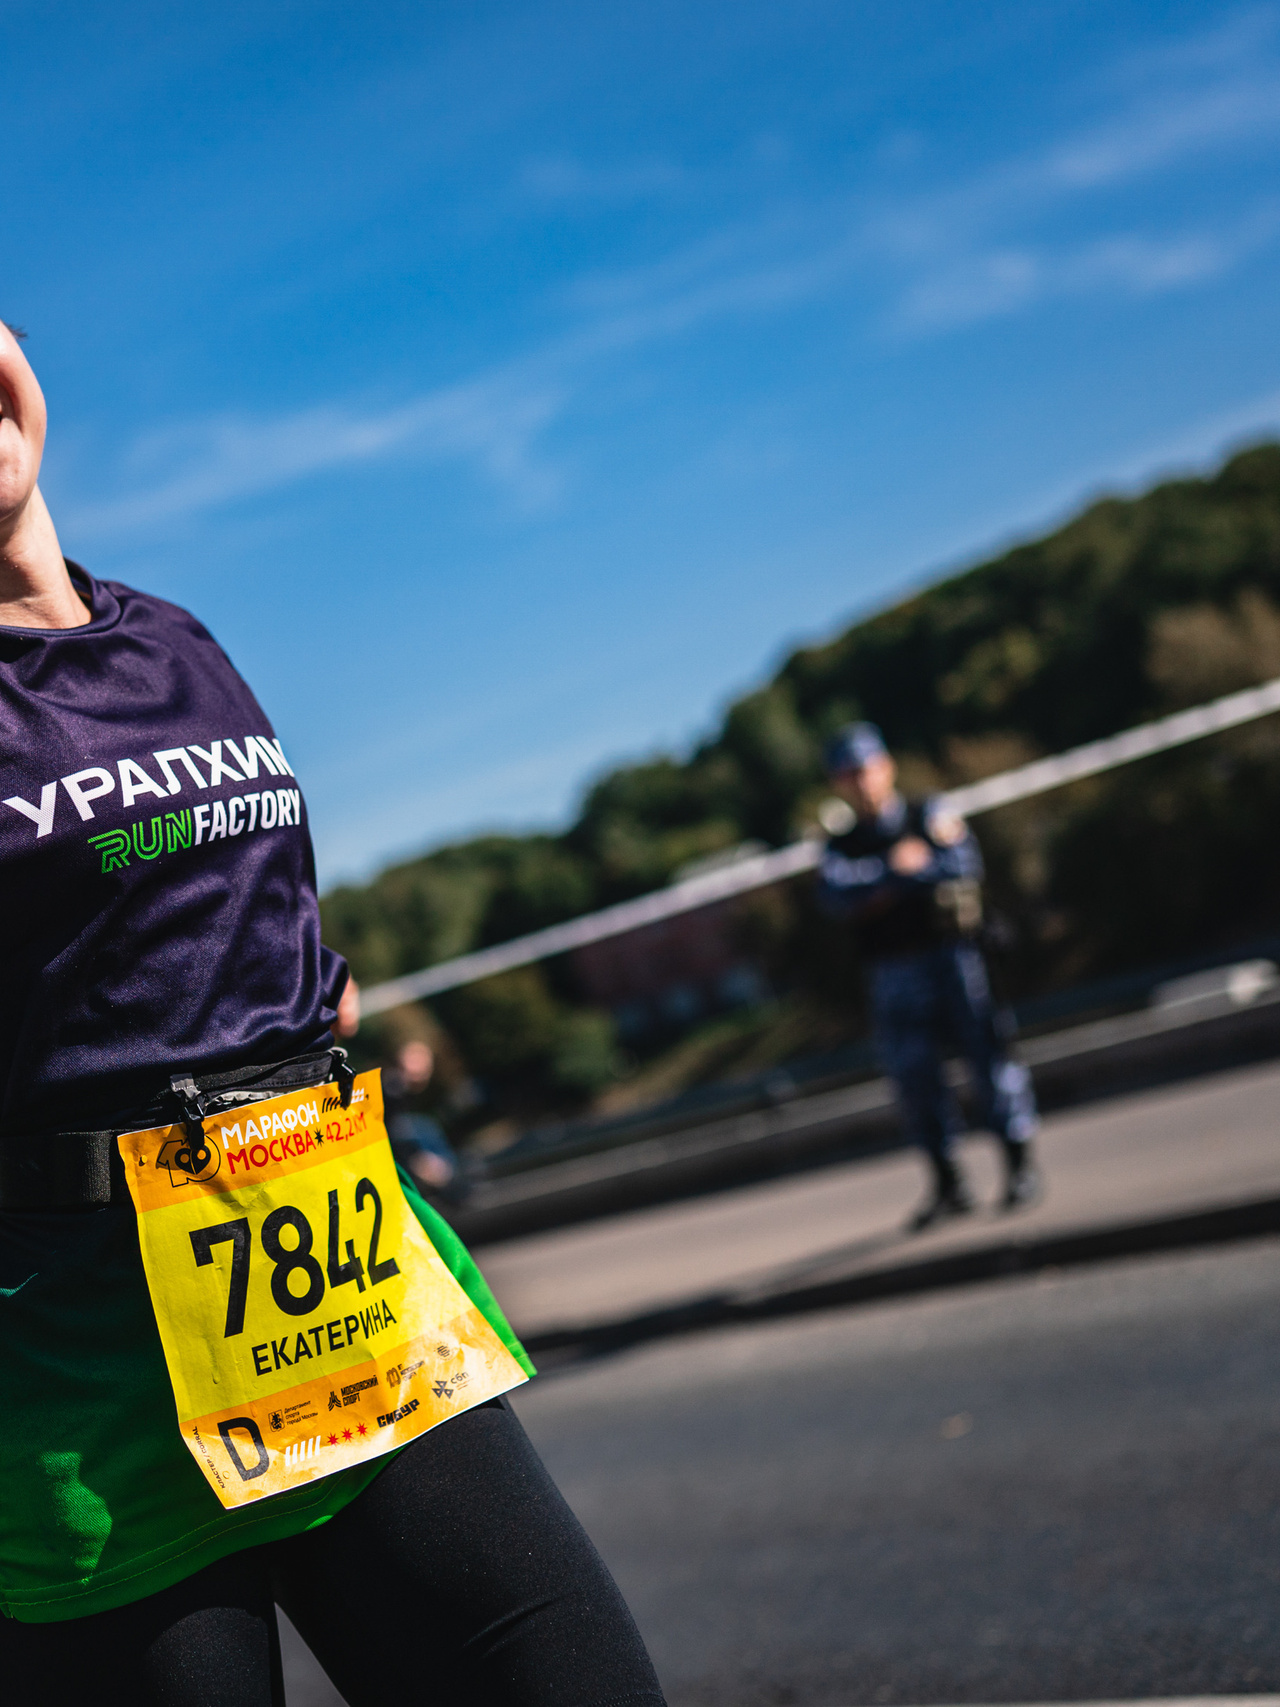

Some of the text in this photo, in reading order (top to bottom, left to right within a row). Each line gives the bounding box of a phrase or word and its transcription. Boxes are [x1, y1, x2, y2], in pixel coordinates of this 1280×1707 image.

[220, 1100, 320, 1149] МАРАФОН
[226, 1129, 317, 1175] МОСКВА
[188, 1177, 401, 1339] 7842
[251, 1298, 397, 1377] ЕКАТЕРИНА
[340, 1374, 379, 1396] МОСКОВСКИЙ
[342, 1392, 361, 1407] СПОРТ
[376, 1398, 420, 1428] СИБУР
[192, 1425, 207, 1454] CORRAL
[217, 1416, 270, 1482] D
[206, 1458, 226, 1489] КЛАСТЕР
